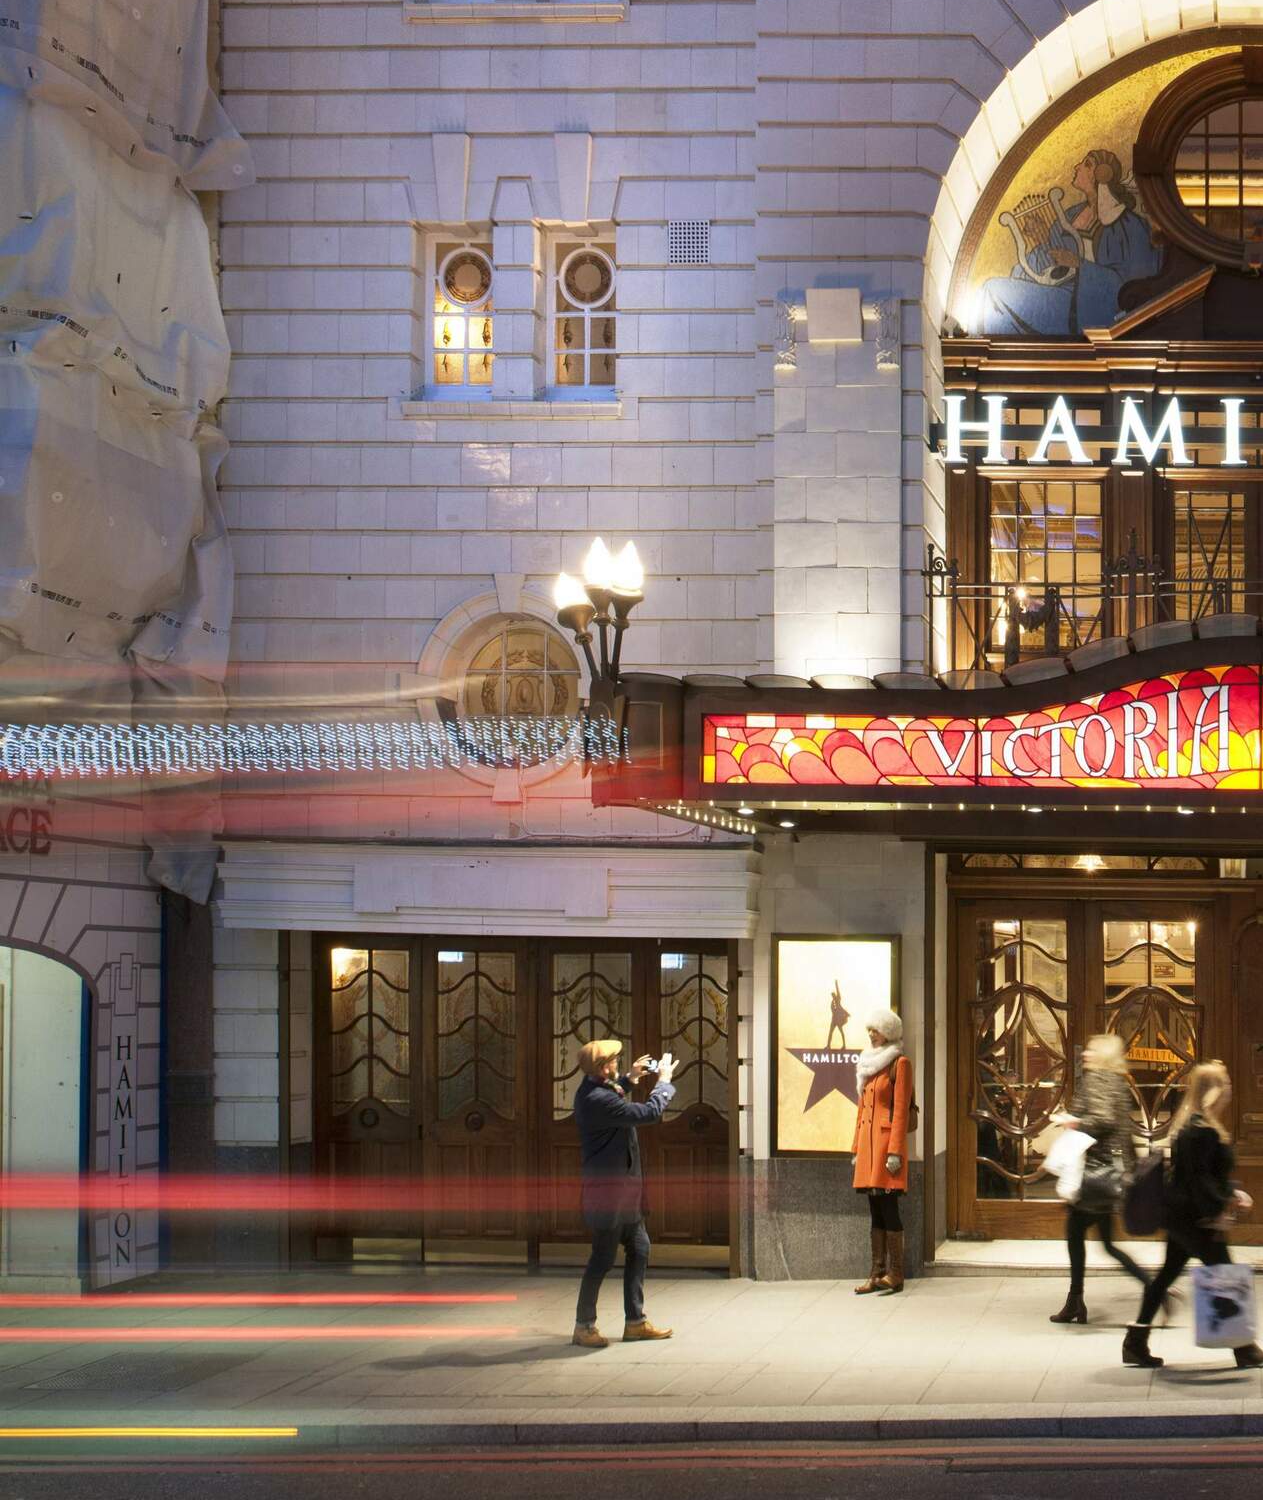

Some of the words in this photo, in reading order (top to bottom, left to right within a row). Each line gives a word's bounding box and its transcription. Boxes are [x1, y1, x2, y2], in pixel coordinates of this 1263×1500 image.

[925, 683, 1230, 778] VICTORIA
[0, 805, 53, 856] CE
[803, 1053, 859, 1064] HAMILTO
[1128, 1049, 1179, 1061] HAMILTO
[114, 1035, 133, 1268] HAMILTON
